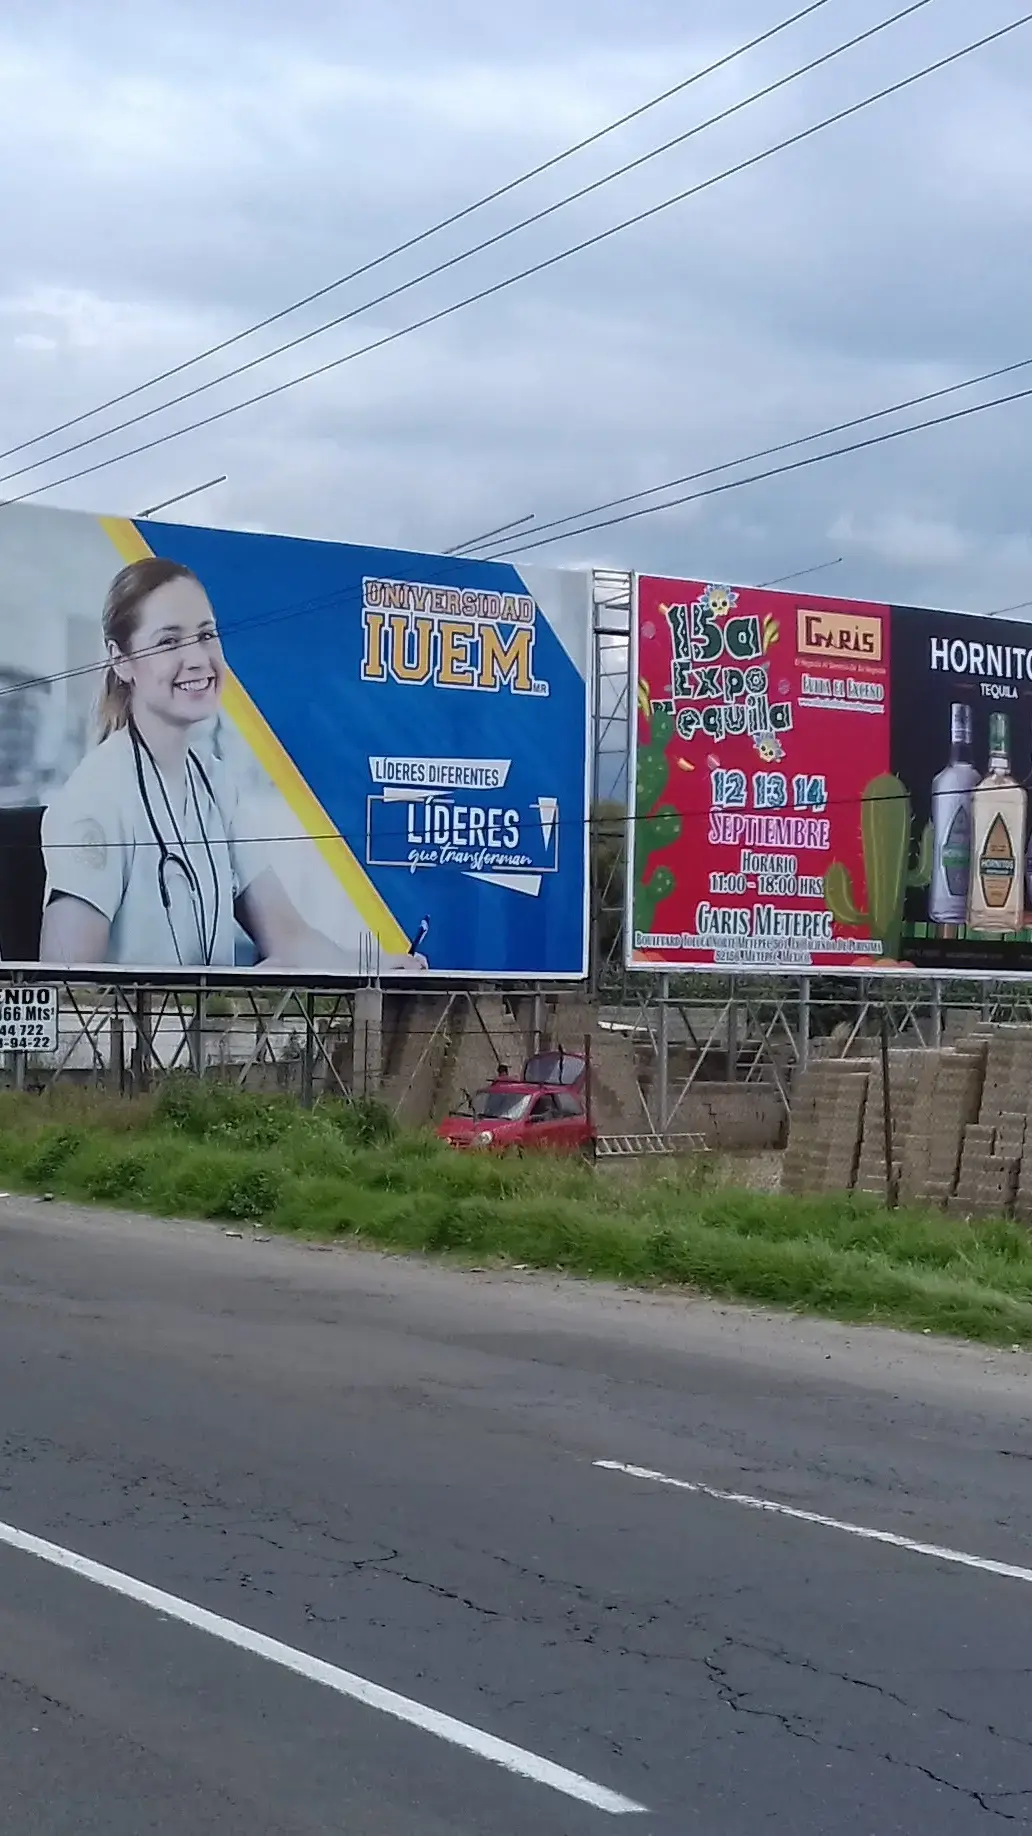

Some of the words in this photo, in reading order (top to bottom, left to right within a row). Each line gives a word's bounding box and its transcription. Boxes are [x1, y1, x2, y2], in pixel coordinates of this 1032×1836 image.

[364, 579, 533, 623] UNIVERSIDAD
[363, 610, 533, 691] IUEM
[980, 682, 1019, 700] TEQUILA
[375, 757, 425, 782] LÍDERES
[428, 764, 500, 787] DIFERENTES
[712, 770, 747, 808] 12
[753, 773, 787, 809] 13
[793, 775, 827, 812] 14
[407, 795, 520, 849] LÍDERES
[709, 809, 829, 848] SEPTIEMBRE
[407, 848, 439, 874] que
[439, 842, 533, 871] transforman
[741, 850, 796, 873] HORARIO
[710, 874, 746, 893] 11:00
[759, 876, 797, 894] 18:00
[697, 903, 749, 936] GARIS
[755, 906, 832, 938] METEPEC
[0, 988, 50, 1005] NDO
[0, 1006, 21, 1021] 66
[20, 1024, 44, 1036] 722
